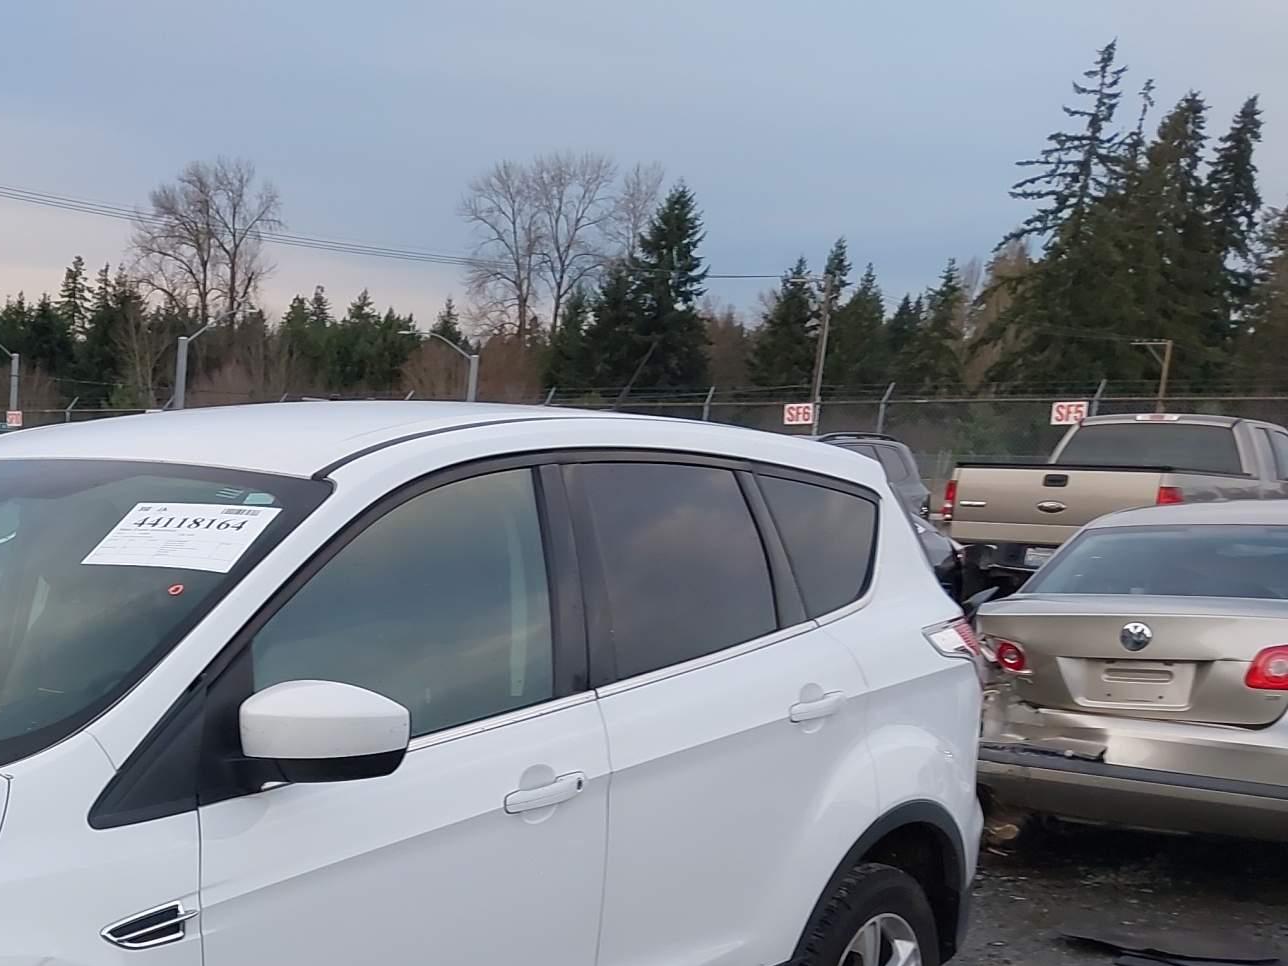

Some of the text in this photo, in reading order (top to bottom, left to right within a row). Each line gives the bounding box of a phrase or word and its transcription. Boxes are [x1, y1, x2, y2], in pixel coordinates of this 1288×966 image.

[787, 406, 810, 422] SF6
[1055, 404, 1084, 422] SF5
[133, 516, 248, 531] 44118164
